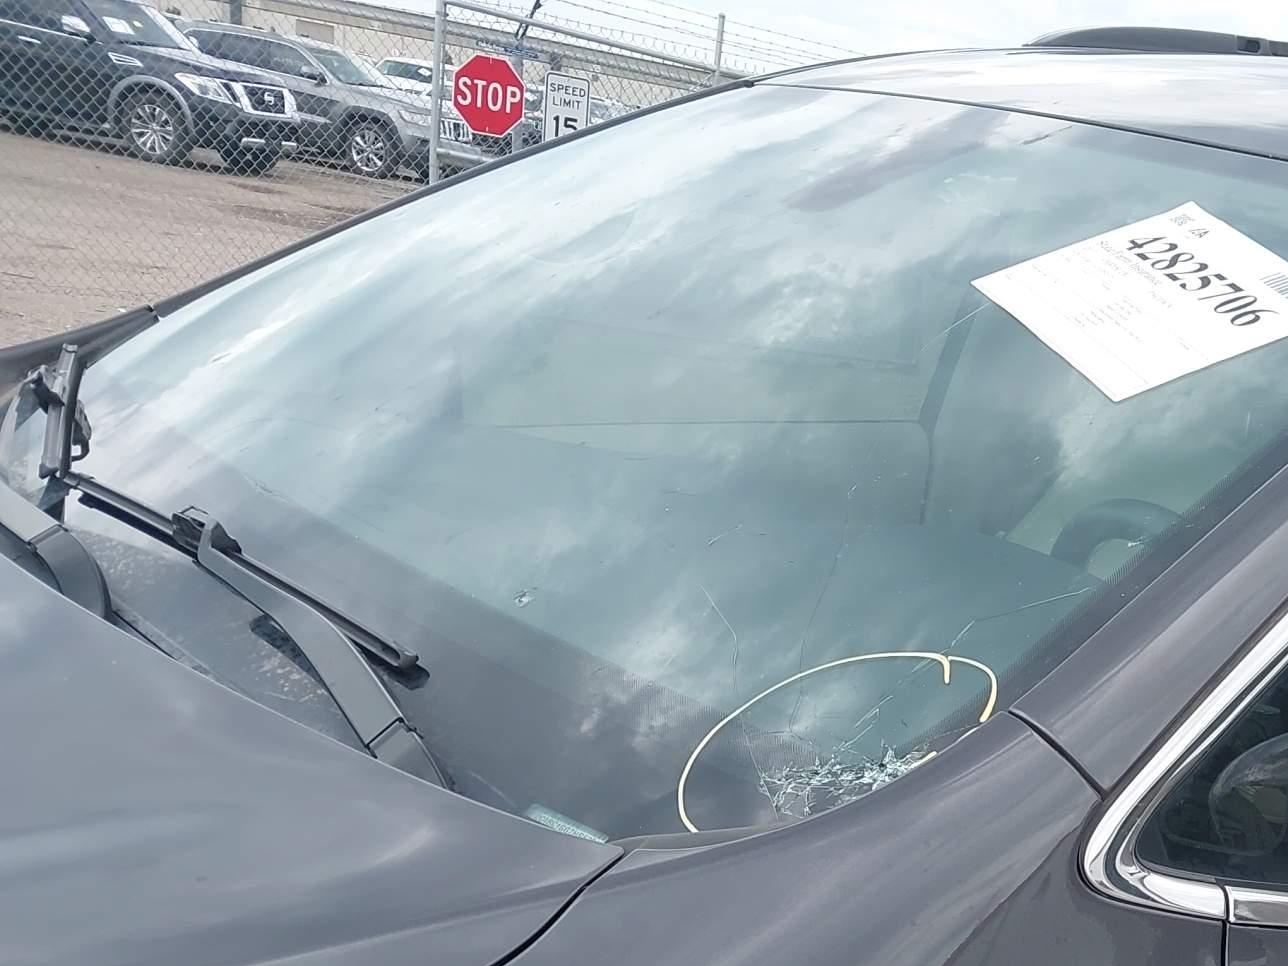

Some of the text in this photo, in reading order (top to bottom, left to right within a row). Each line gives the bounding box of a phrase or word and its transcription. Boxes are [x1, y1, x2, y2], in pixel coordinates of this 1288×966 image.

[456, 76, 521, 114] STOP
[549, 83, 586, 97] SPEED
[552, 96, 582, 111] LIMIT
[552, 114, 579, 138] 15
[1126, 234, 1280, 328] 42825706
